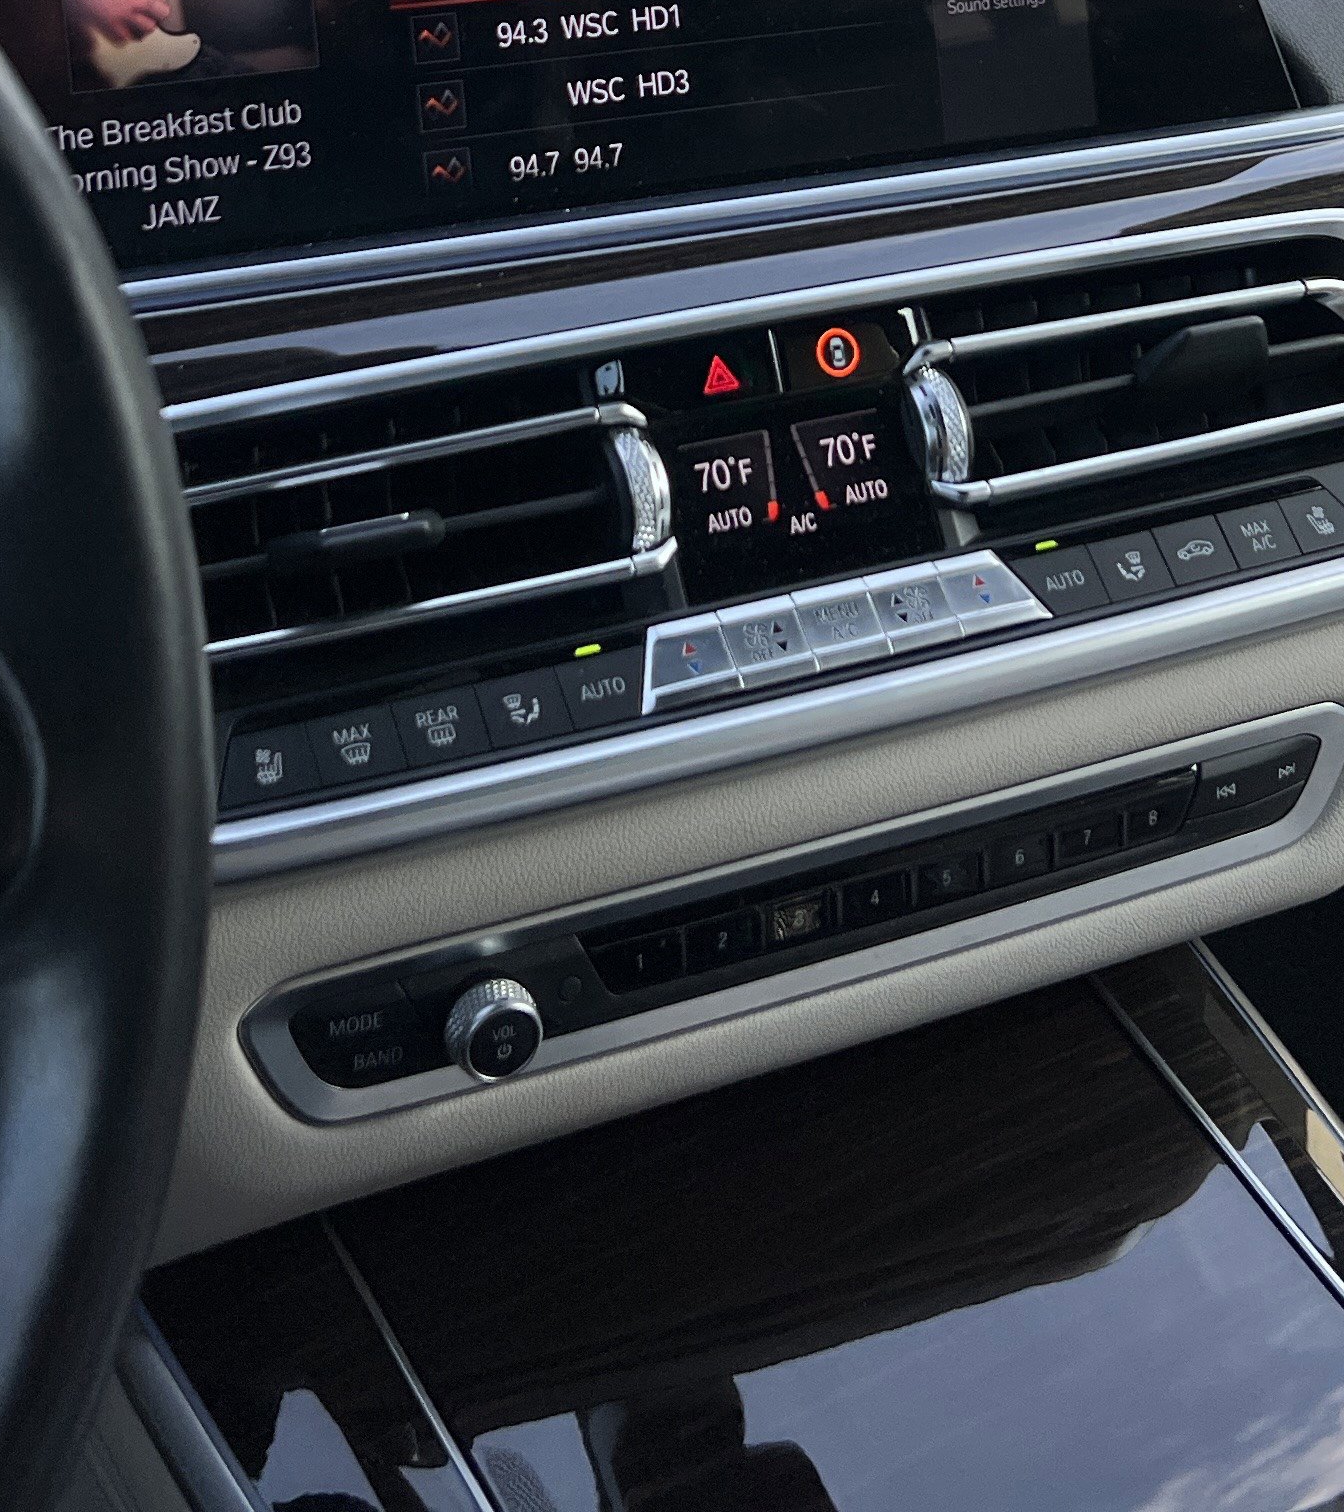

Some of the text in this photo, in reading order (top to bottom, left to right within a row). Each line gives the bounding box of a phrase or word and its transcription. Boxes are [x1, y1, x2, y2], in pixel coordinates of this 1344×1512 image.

[496, 4, 680, 48] 94.3 WSC HD1
[566, 69, 690, 106] WSC HD3
[102, 108, 235, 147] Breakfast
[241, 99, 302, 131] Club
[70, 163, 157, 194] orning
[164, 152, 240, 184] Show
[262, 141, 312, 171] Z93
[509, 143, 623, 181] 94.7 94.7
[142, 195, 222, 231] JAMZ
[819, 432, 876, 468] 70°F
[694, 456, 753, 494] 70°F
[846, 478, 888, 506] AUTO
[708, 505, 753, 535] AUTO
[789, 512, 818, 535] A/C
[1240, 519, 1271, 539] MAX
[1251, 534, 1278, 553] A/C
[1045, 568, 1086, 592] AUTO
[580, 676, 627, 702] AUTO
[415, 705, 460, 729] REAR
[333, 722, 372, 746] MAX
[328, 1010, 384, 1038] MODE
[492, 1023, 518, 1041] VOL
[353, 1045, 404, 1072] BAND
